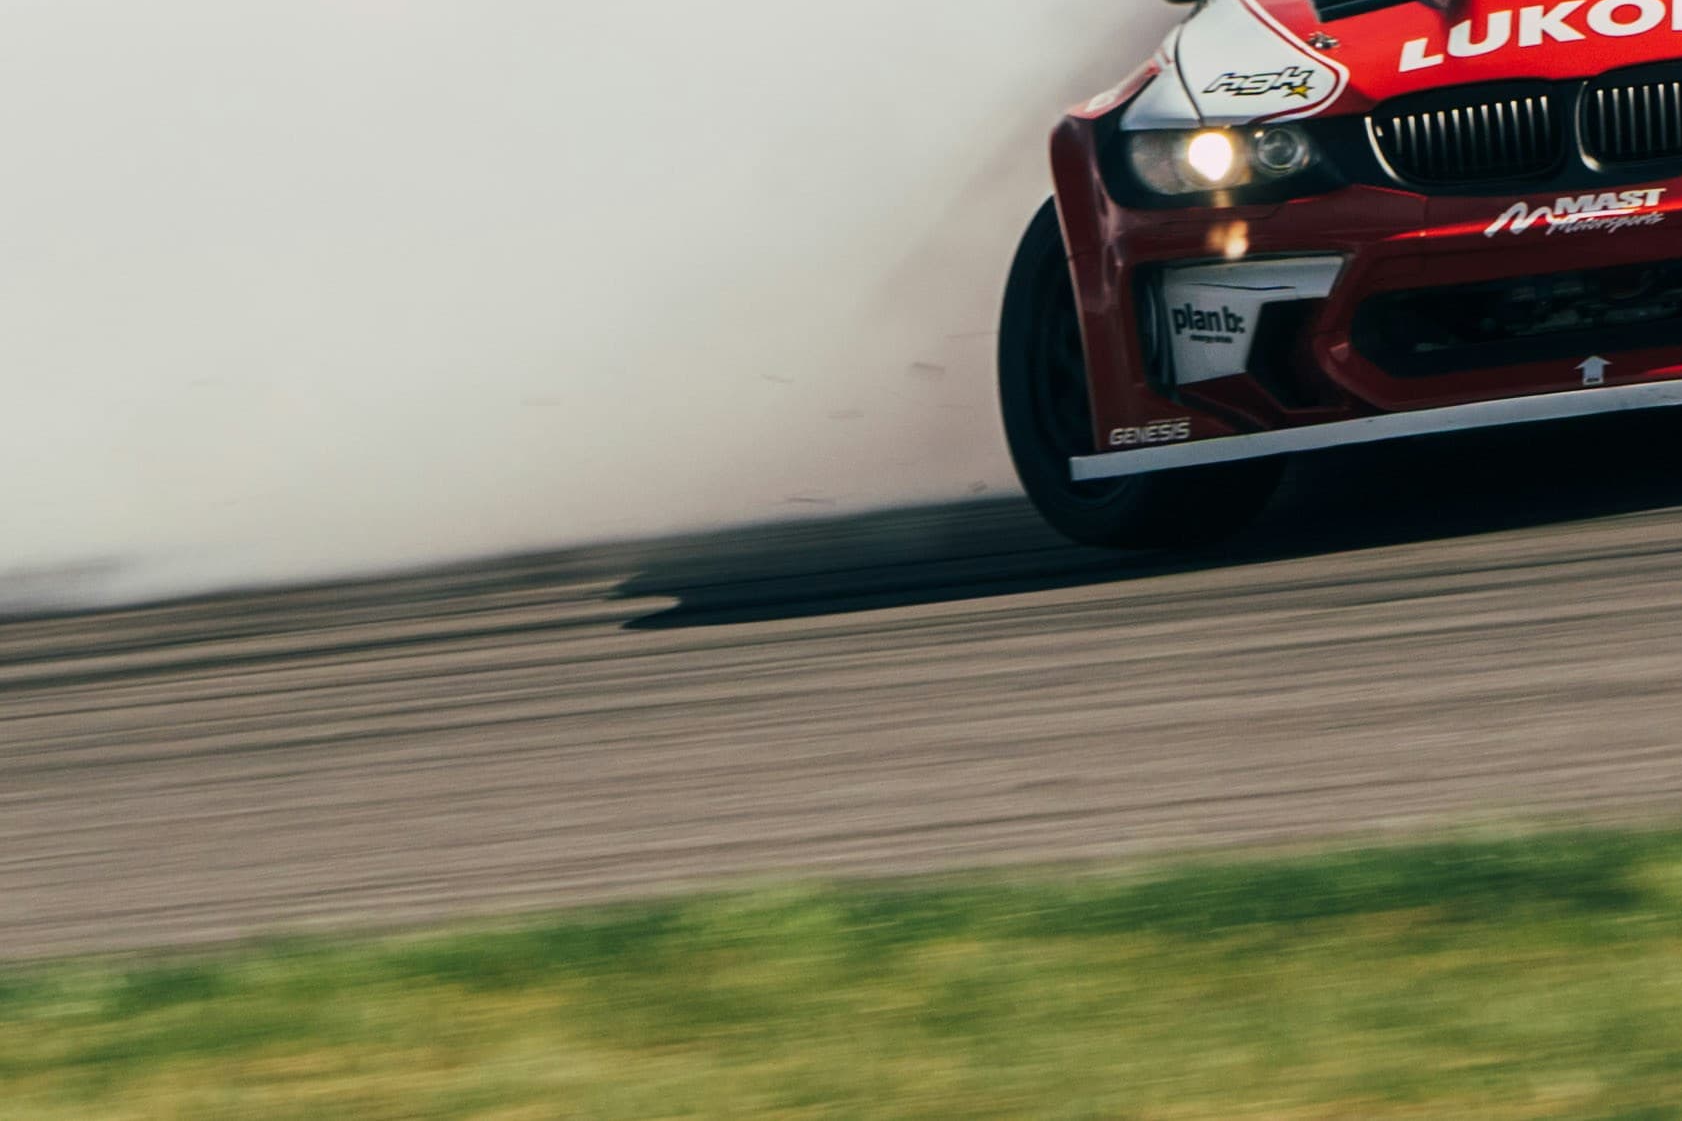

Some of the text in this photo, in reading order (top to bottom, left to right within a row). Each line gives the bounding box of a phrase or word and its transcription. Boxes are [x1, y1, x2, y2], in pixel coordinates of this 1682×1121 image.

[1553, 188, 1667, 216] MAST
[1172, 303, 1222, 335] plan
[1109, 421, 1191, 446] GENESIS
